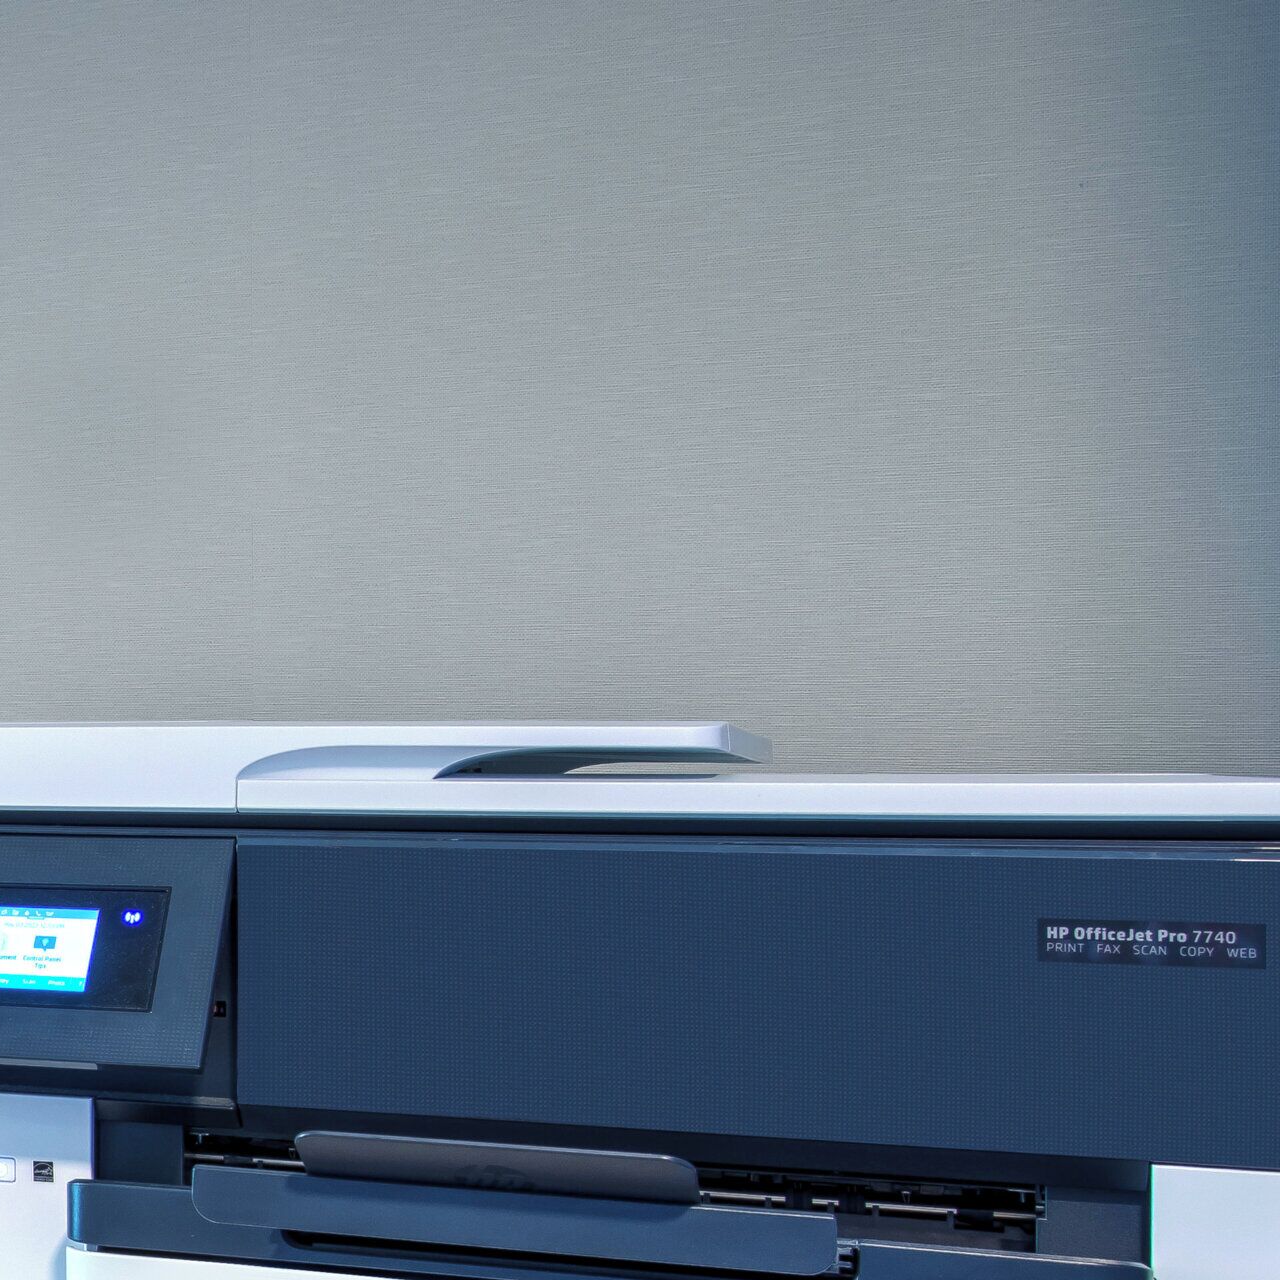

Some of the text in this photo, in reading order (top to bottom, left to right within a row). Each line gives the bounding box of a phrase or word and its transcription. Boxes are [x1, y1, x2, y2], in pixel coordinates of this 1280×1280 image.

[1046, 926, 1237, 944] HP OfficeJet Pro 7740
[1046, 942, 1257, 959] PRINT FAX SCAN COPY WEB
